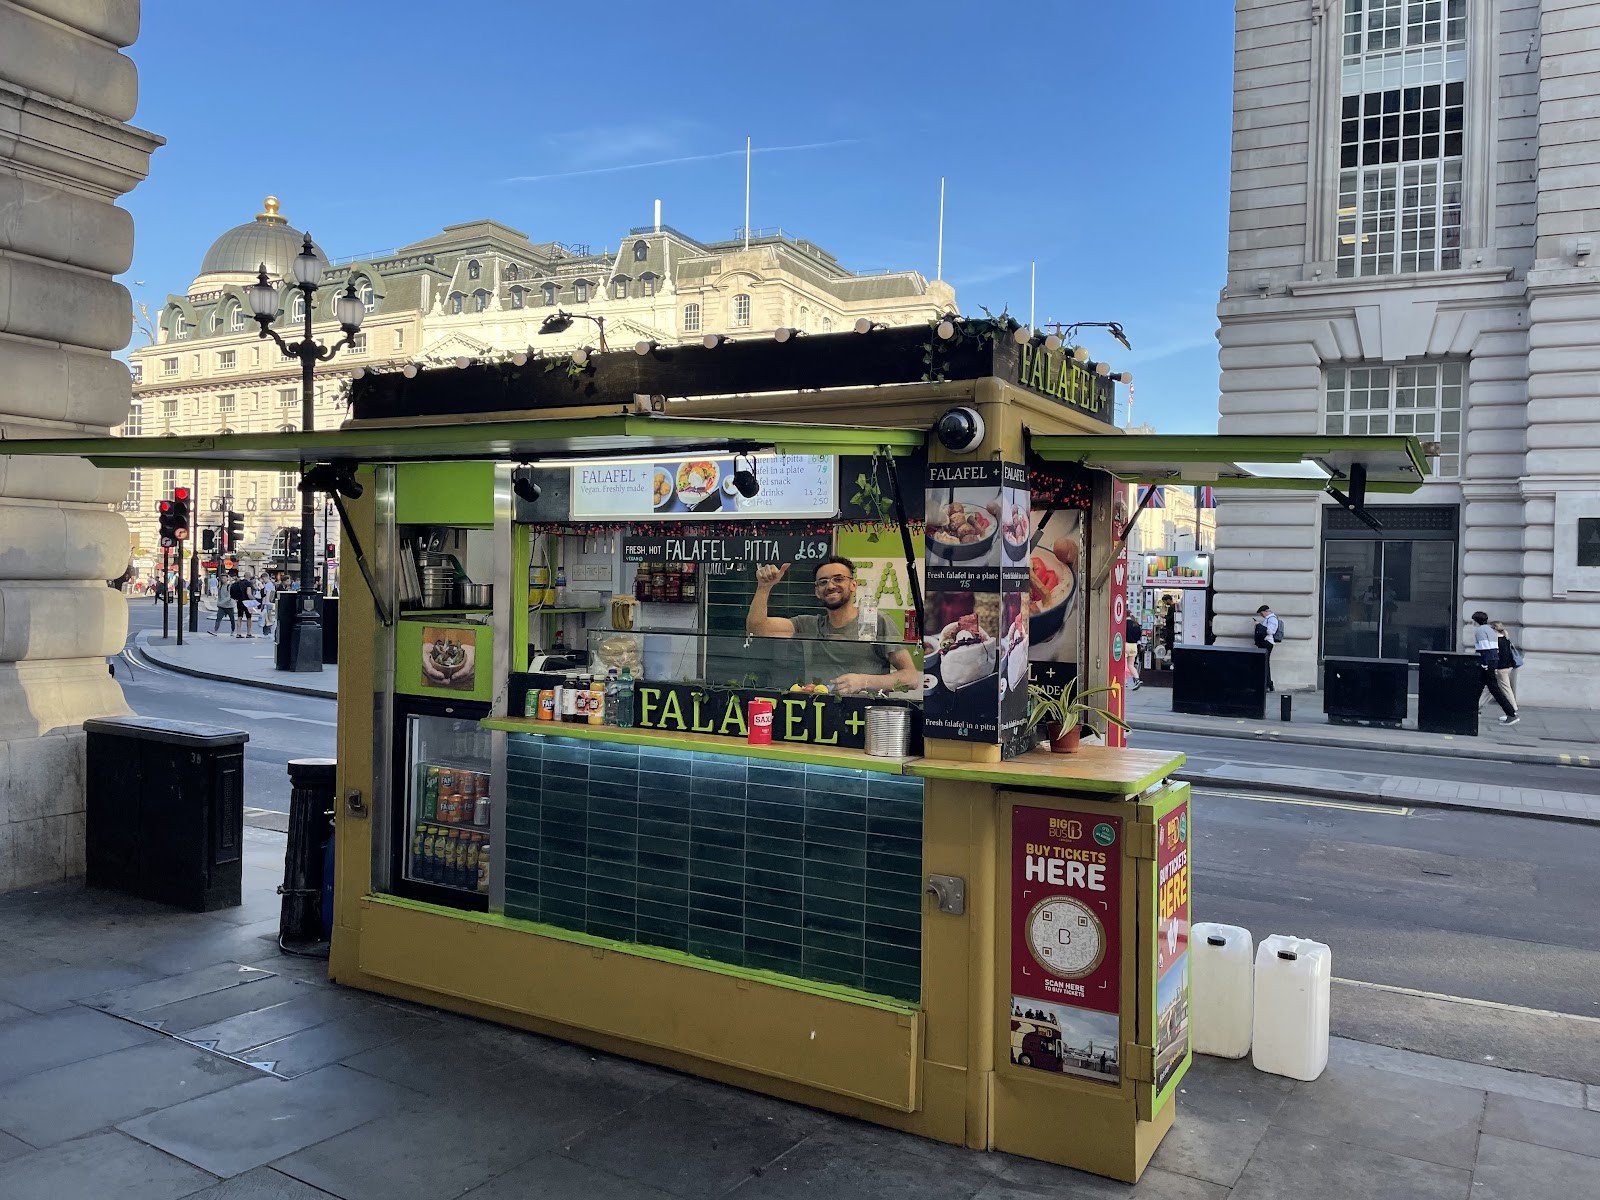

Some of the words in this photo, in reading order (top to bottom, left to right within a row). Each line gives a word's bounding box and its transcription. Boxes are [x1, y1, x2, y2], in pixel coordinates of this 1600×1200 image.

[1020, 342, 1099, 413] FALAFEL
[582, 469, 636, 484] FALAFEL
[786, 465, 805, 476] plate
[929, 466, 988, 481] FALAFEL
[1004, 466, 1026, 483] FALAFEL
[770, 477, 791, 485] snack
[580, 485, 602, 496] Vegan.
[602, 484, 626, 495] Freshly
[760, 488, 784, 497] drinks
[649, 545, 662, 555] HOT
[665, 539, 732, 561] FALAFEL
[744, 539, 780, 561] PITTA
[794, 540, 828, 561] £6.9
[927, 571, 945, 580] Fresh
[946, 571, 967, 580] falafel
[967, 571, 975, 579] in
[981, 571, 999, 581] plate
[925, 718, 944, 727] Fresh
[944, 719, 965, 728] falafel
[980, 722, 996, 732] pitta
[1049, 817, 1068, 829] BIG
[1049, 828, 1067, 838] BUS
[1026, 842, 1051, 857] BUY
[1053, 846, 1107, 864] TICKETS
[1168, 849, 1187, 877] TICKETS
[1025, 855, 1107, 892] HERE
[1159, 866, 1187, 927] HERE
[1044, 979, 1064, 988] SCAN
[1065, 982, 1085, 993] HERE
[1052, 986, 1063, 994] BUY
[1063, 988, 1085, 998] TICKETS
